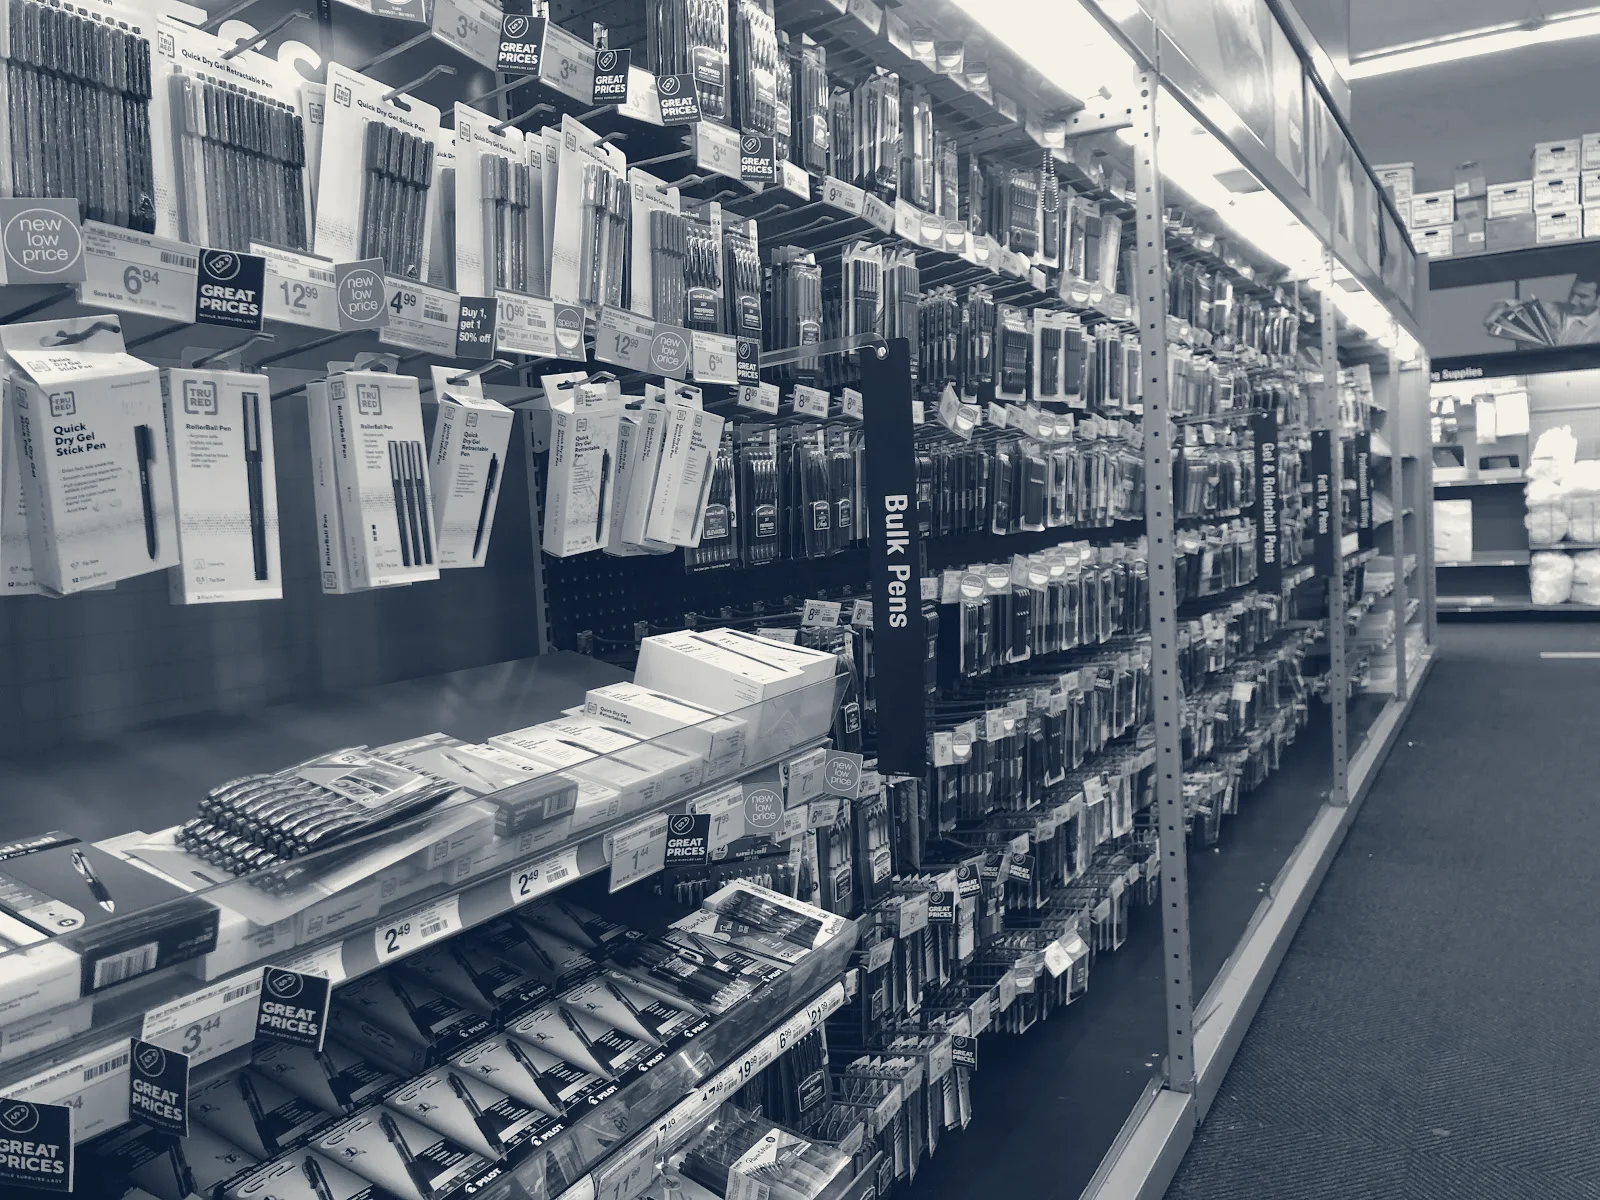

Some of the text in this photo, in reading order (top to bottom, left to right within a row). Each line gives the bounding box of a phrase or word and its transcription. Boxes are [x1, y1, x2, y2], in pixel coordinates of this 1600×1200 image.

[501, 42, 537, 54] GREAT
[499, 53, 538, 64] PRICES
[182, 49, 273, 89] Quick Dry Gel Retractable Pen
[596, 75, 624, 84] GREAT
[595, 84, 626, 94] PRICES
[661, 97, 693, 107] GREAT
[357, 99, 426, 133] Quick Dry Gel Stick Pen
[662, 106, 698, 116] PRICES
[474, 133, 486, 142] Quick
[486, 138, 494, 147] Dry
[501, 144, 510, 152] Stick
[579, 145, 591, 155] Quick
[742, 157, 770, 166] GREAT
[742, 165, 773, 175] PRICES
[20, 218, 61, 232] new
[27, 231, 58, 246] low
[22, 246, 69, 265] price
[347, 276, 374, 289] new
[201, 284, 255, 302] GREAT
[351, 288, 372, 300] low
[200, 298, 258, 315] PRICES
[348, 299, 378, 315] price
[462, 307, 486, 319] Buy 1,
[460, 319, 475, 329] get
[558, 318, 580, 329] special
[459, 331, 491, 343] 50% off
[660, 337, 681, 348] new
[662, 346, 677, 356] low
[657, 356, 679, 366] price
[738, 361, 756, 371] GREAT
[738, 370, 758, 379] PRICES
[1442, 367, 1483, 380] Supplies
[190, 388, 211, 398] TRU
[190, 396, 211, 407] RED
[362, 400, 377, 408] RED
[54, 404, 71, 412] RED
[54, 423, 86, 436] Quick
[55, 432, 95, 447] Dry Gel
[56, 442, 106, 457] Stick Pen
[1261, 443, 1278, 564] Gel & Rollerball Pens
[1316, 474, 1328, 535] Felt Tip Pens
[884, 494, 911, 629] Bulk Pens
[832, 760, 853, 770] new
[833, 769, 850, 778] low
[830, 776, 852, 788] price
[751, 793, 774, 804] new
[754, 802, 772, 813] low
[752, 810, 776, 822] price
[668, 838, 703, 848] GREAT
[667, 847, 705, 856] PRICES
[1010, 869, 1030, 879] PRICES
[1011, 864, 1030, 873] GREAT
[959, 879, 977, 888] GREAT
[959, 884, 980, 893] PRICES
[768, 969, 783, 980] PILOT
[528, 985, 547, 998] PILOT
[263, 1002, 316, 1020] GREAT
[260, 1014, 318, 1036] PRICES
[468, 1021, 489, 1036] PILOT
[692, 1021, 709, 1034] PILOT
[647, 1052, 665, 1066] PILOT
[952, 1049, 973, 1057] GREAT
[952, 1055, 975, 1064] PRICES
[133, 1079, 178, 1101] GREAT
[598, 1085, 618, 1103] PILOT
[133, 1092, 182, 1122] PRICES
[542, 1124, 563, 1143] PILOT
[0, 1140, 59, 1158] GREAT
[475, 1168, 502, 1187] PILOT
